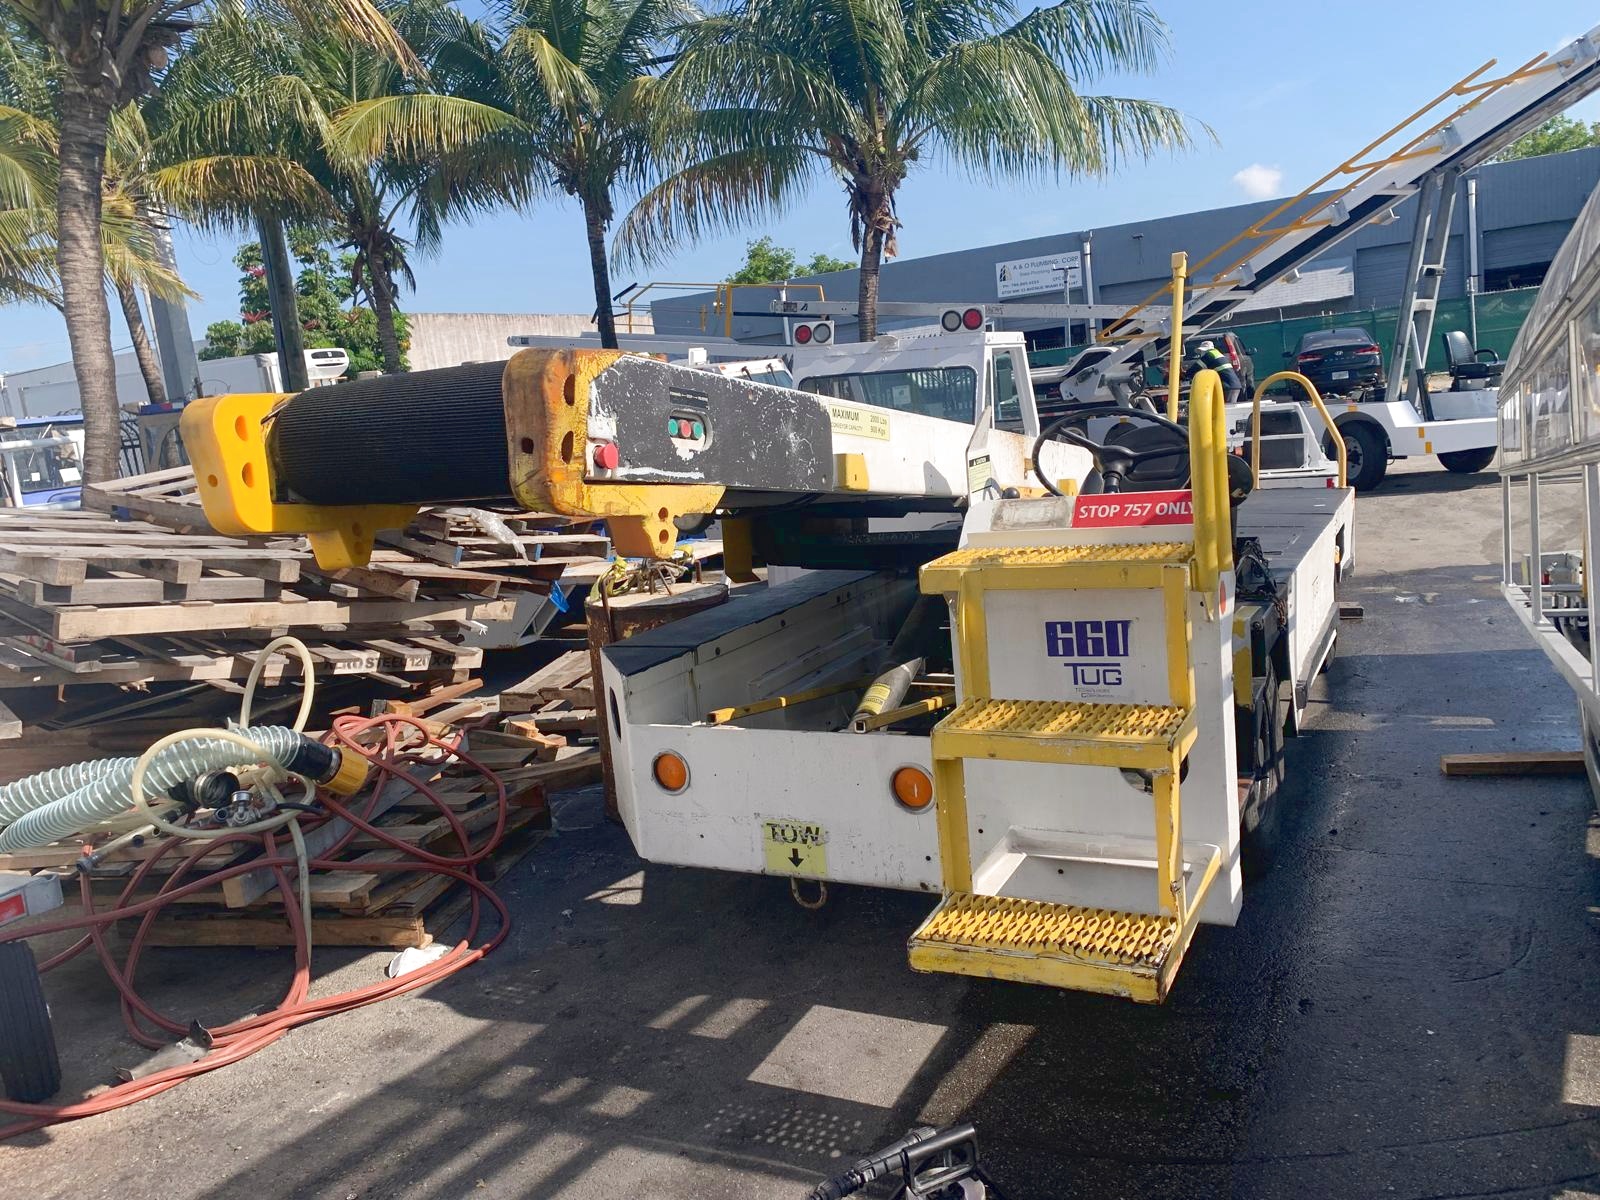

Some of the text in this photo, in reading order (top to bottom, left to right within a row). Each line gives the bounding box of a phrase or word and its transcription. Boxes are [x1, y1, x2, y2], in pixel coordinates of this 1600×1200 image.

[832, 408, 860, 422] MAXIMUM
[1079, 504, 1120, 519] STOP
[1123, 503, 1152, 517] 757
[1045, 620, 1131, 657] 660
[1064, 662, 1122, 686] TUG
[766, 822, 820, 845] TOW
